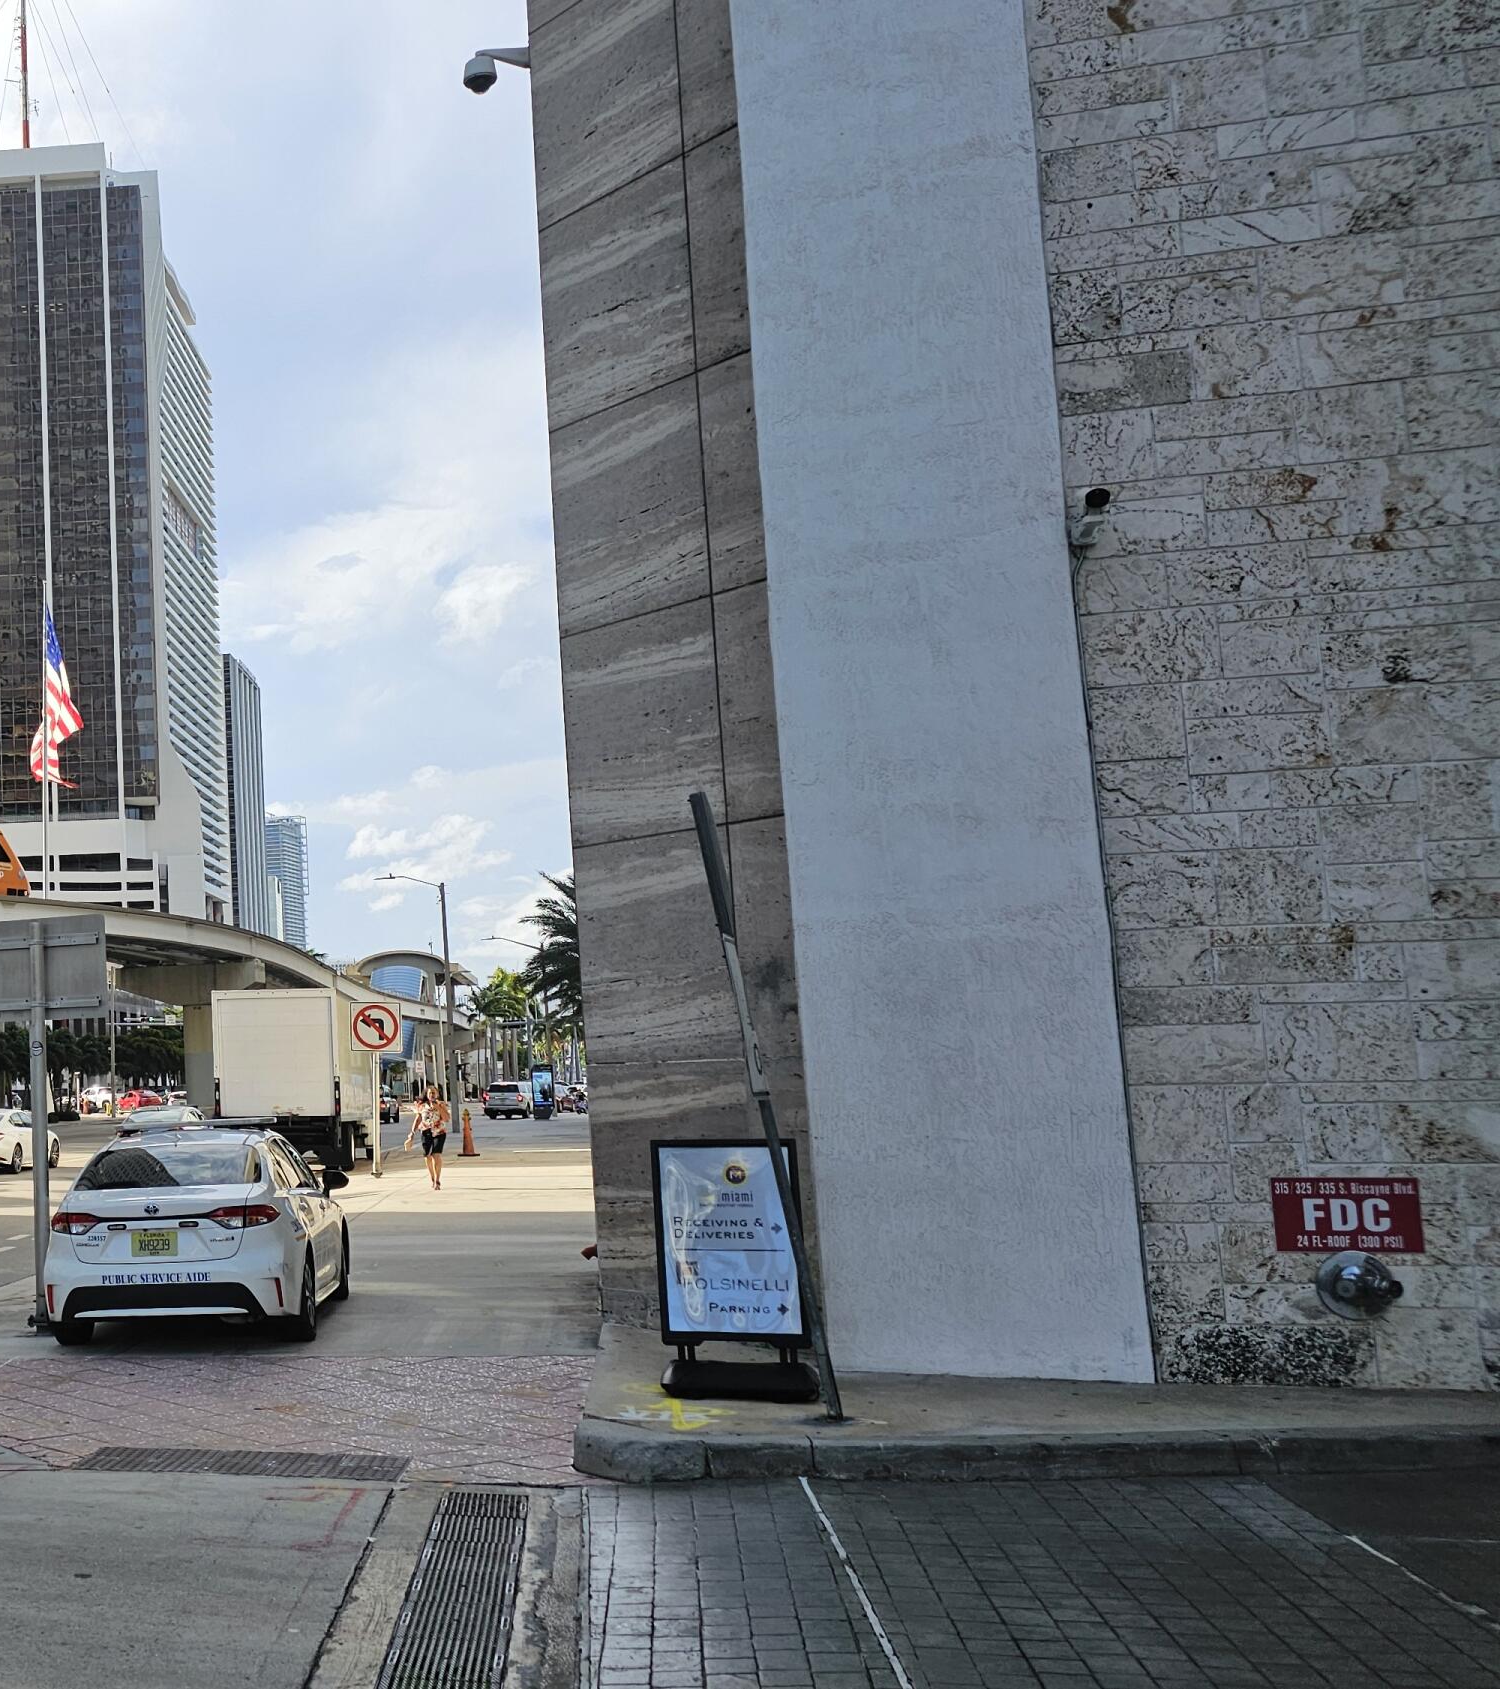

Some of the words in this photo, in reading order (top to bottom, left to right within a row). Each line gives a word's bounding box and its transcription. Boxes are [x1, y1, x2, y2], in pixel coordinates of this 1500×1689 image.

[1350, 1182, 1390, 1196] Biscayne
[721, 1191, 754, 1202] miami
[1302, 1197, 1392, 1232] FDC
[754, 1217, 764, 1228] &
[674, 1228, 755, 1240] DELIVERIES
[138, 1239, 170, 1252] XH9239
[1297, 1235, 1309, 1248] 24
[101, 1274, 138, 1285] PUBLIC
[140, 1272, 182, 1284] SERVICE
[185, 1271, 212, 1282] AIDE
